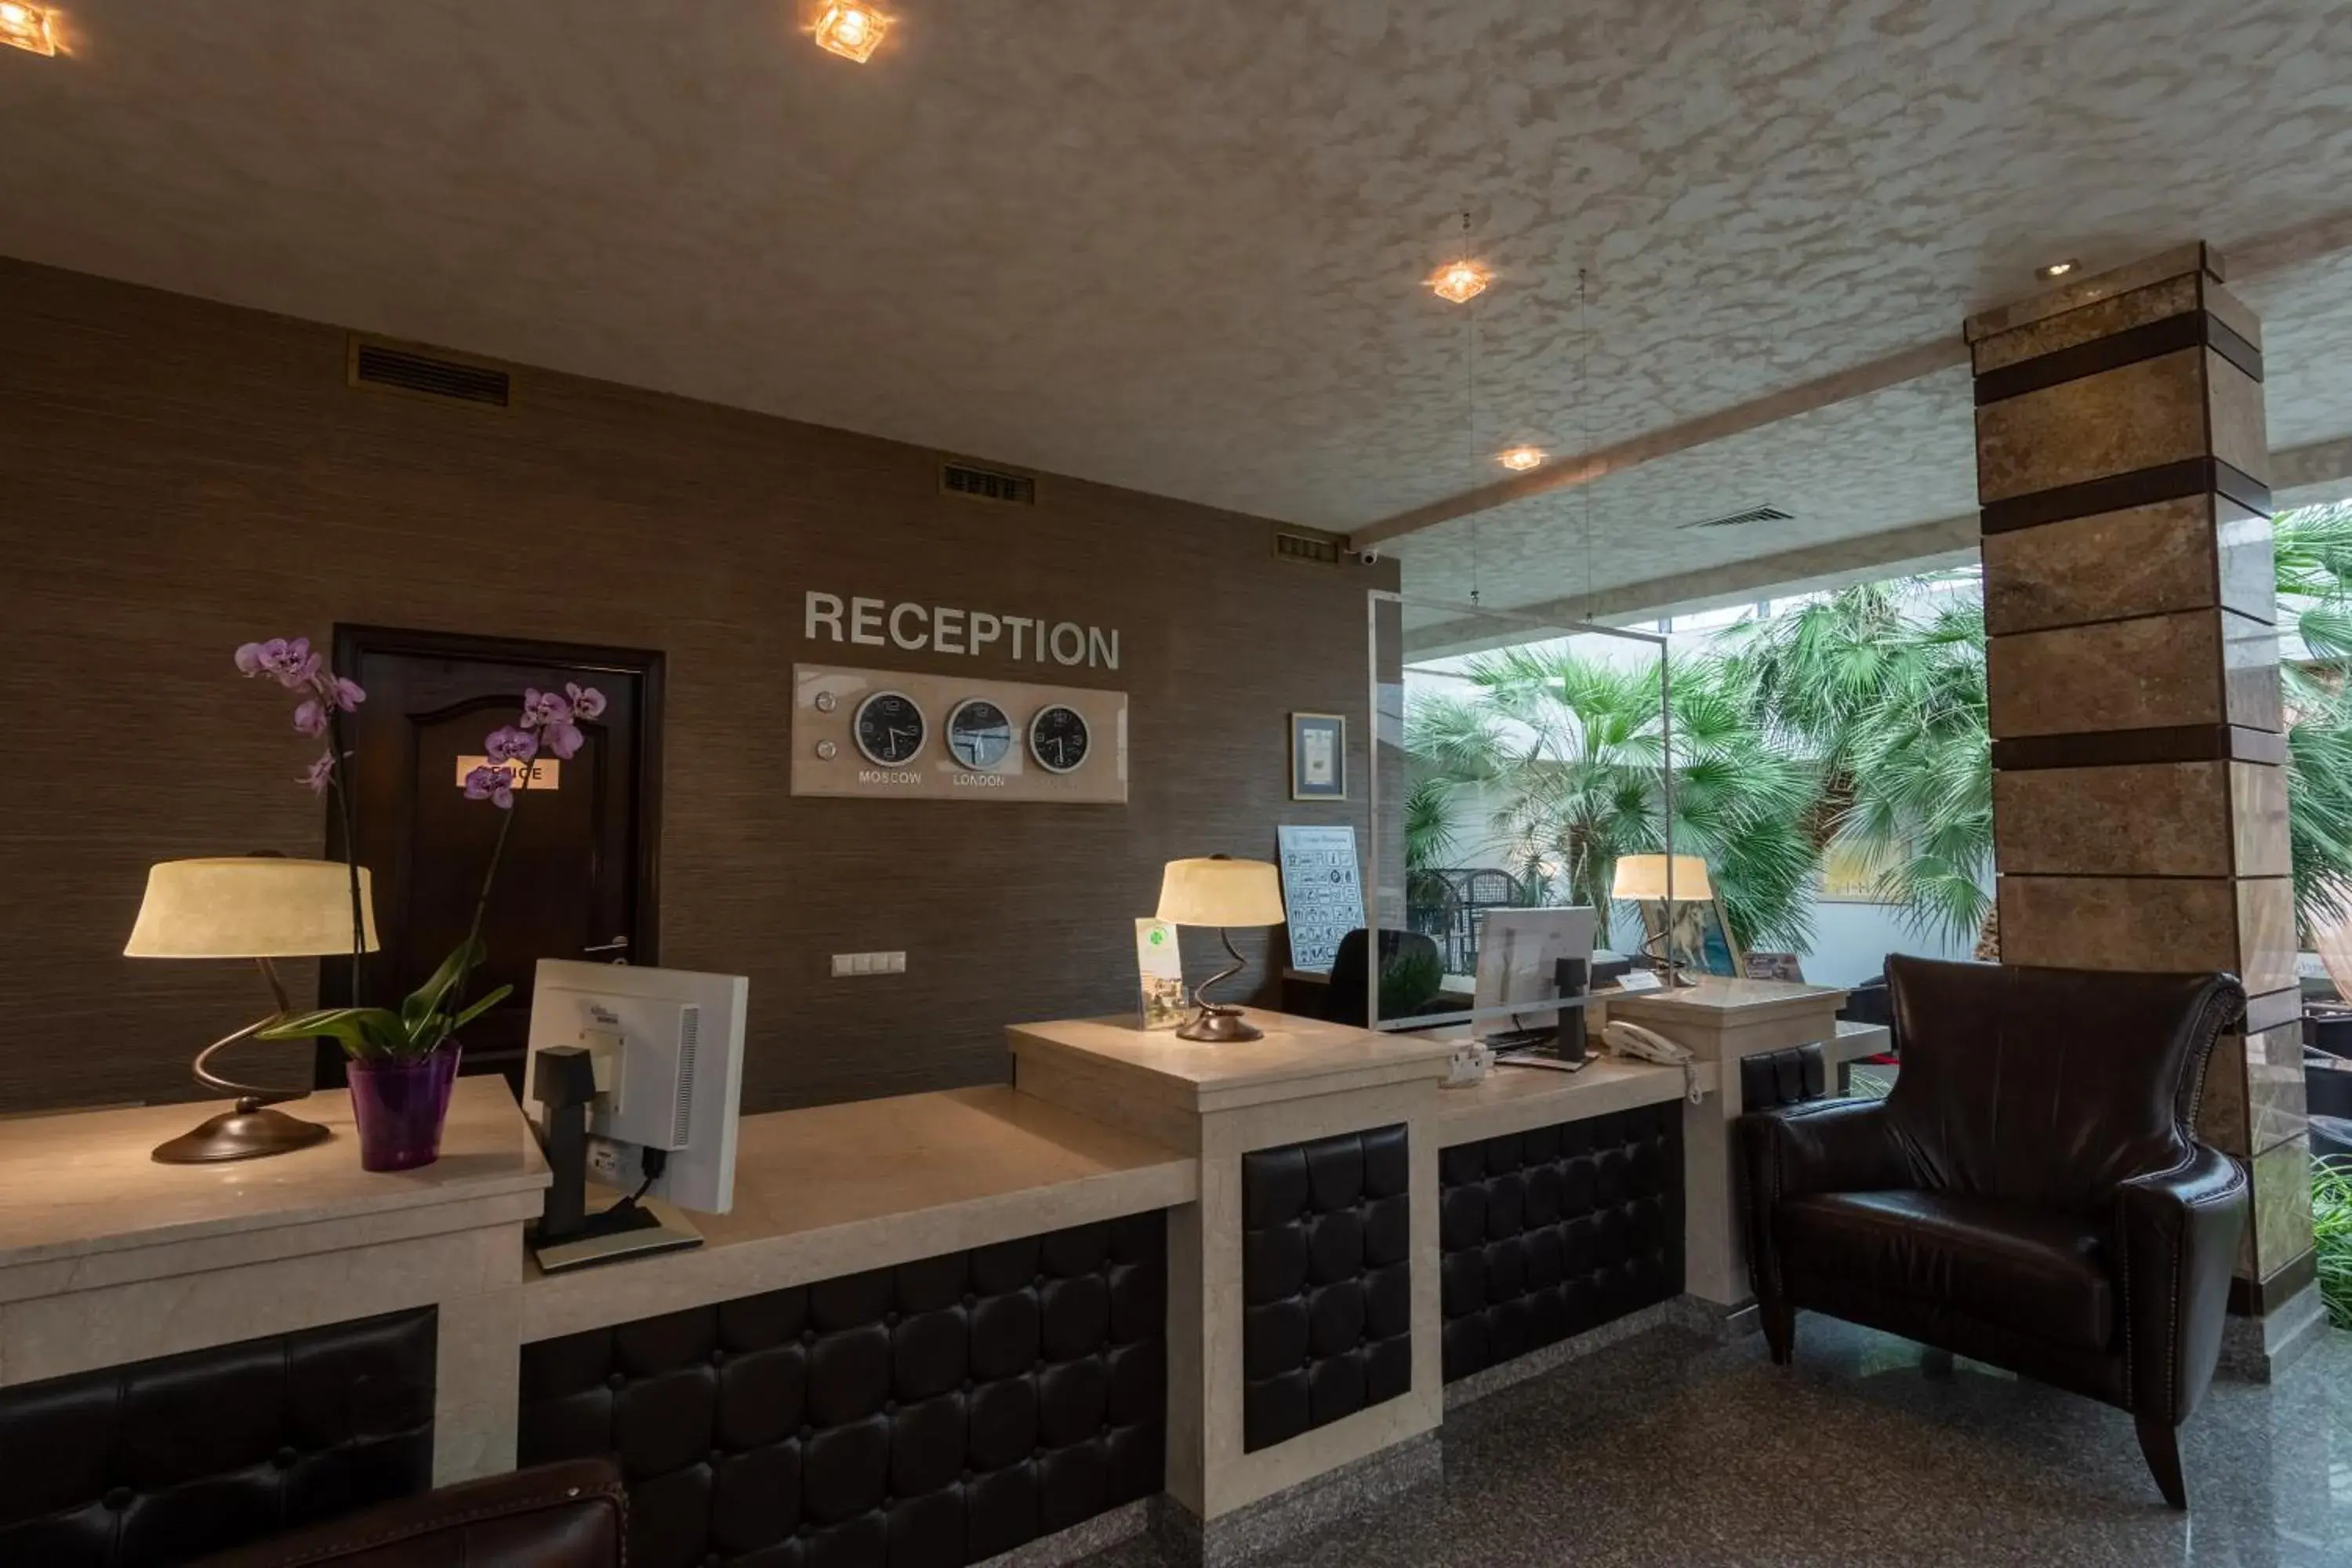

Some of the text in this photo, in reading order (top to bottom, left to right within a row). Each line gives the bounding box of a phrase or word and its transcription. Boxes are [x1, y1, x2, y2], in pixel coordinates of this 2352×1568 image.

[805, 590, 1120, 670] RECEPTION
[858, 770, 921, 785] MOSCOW
[953, 773, 1004, 787] LONDON
